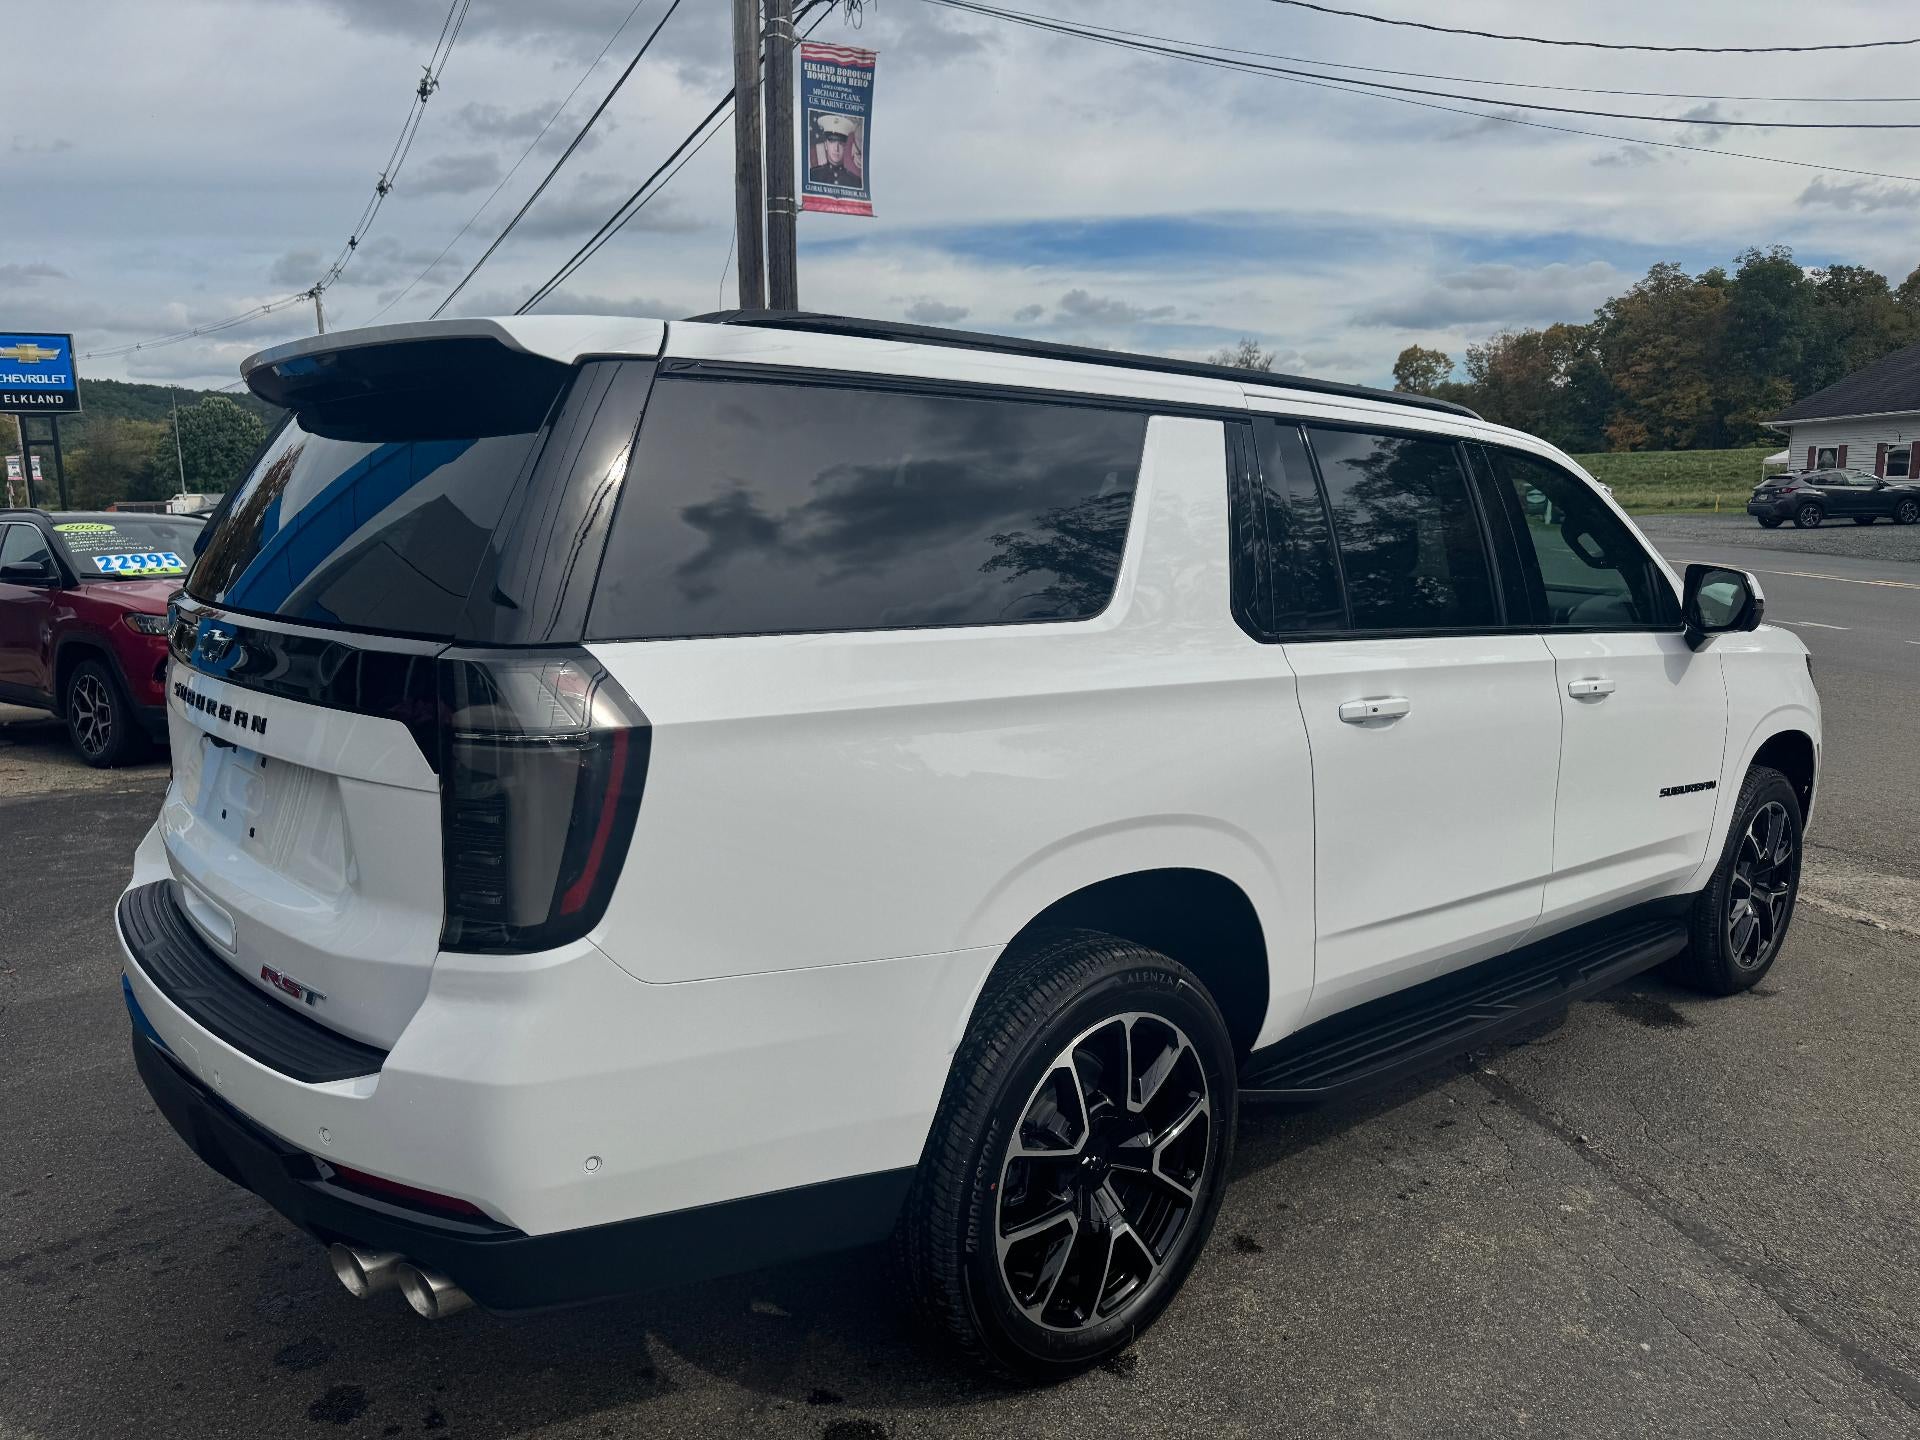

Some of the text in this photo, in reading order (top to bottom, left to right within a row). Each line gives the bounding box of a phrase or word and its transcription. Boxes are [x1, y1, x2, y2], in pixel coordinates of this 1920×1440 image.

[804, 62, 872, 80] ELKLAND BOROUGH
[807, 71, 868, 87] HOMETOWN HERO
[813, 88, 840, 99] MICHAEL
[820, 99, 844, 109] MARINE
[845, 104, 864, 112] CORPS
[4, 394, 64, 404] ELKLAND
[64, 523, 104, 531] 2025
[97, 552, 181, 571] 22995
[173, 681, 268, 735] SUBURBAN
[1659, 780, 1717, 798] SUBURBAN
[260, 961, 328, 1007] RST
